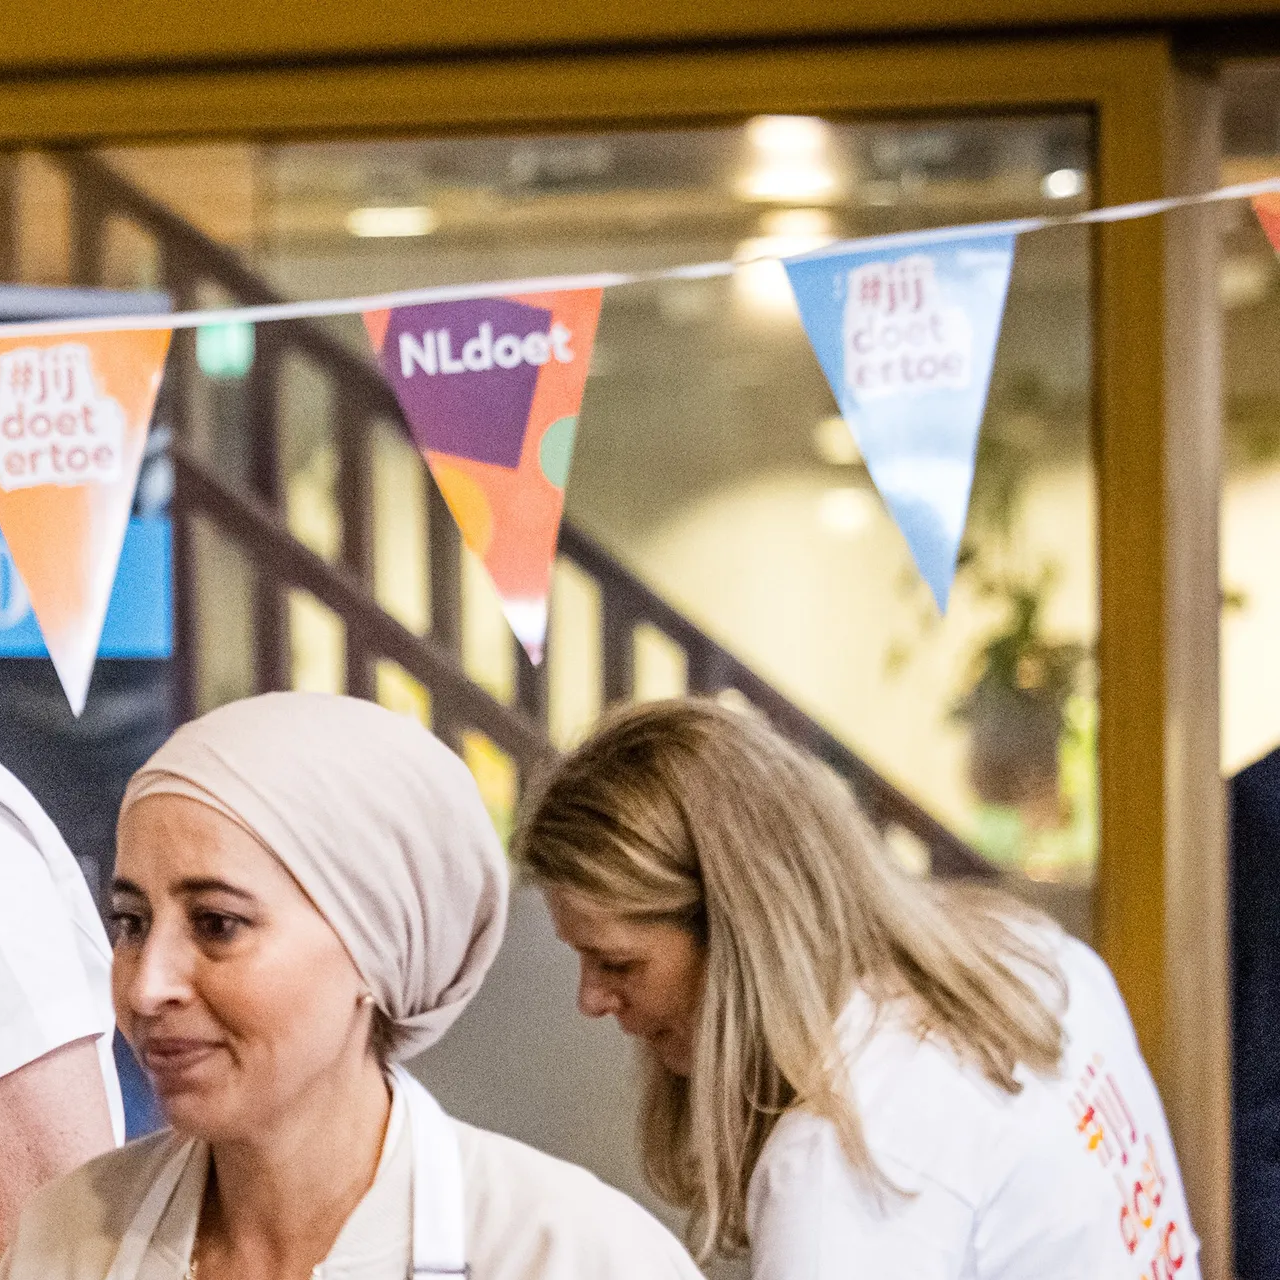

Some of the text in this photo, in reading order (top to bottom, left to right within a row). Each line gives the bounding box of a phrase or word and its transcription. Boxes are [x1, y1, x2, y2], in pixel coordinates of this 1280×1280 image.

[398, 321, 575, 379] NLdoet
[851, 314, 946, 355] doet
[10, 352, 76, 404] #jij
[854, 351, 964, 386] ertoe
[1, 402, 96, 439] doet
[3, 443, 114, 477] ertoe
